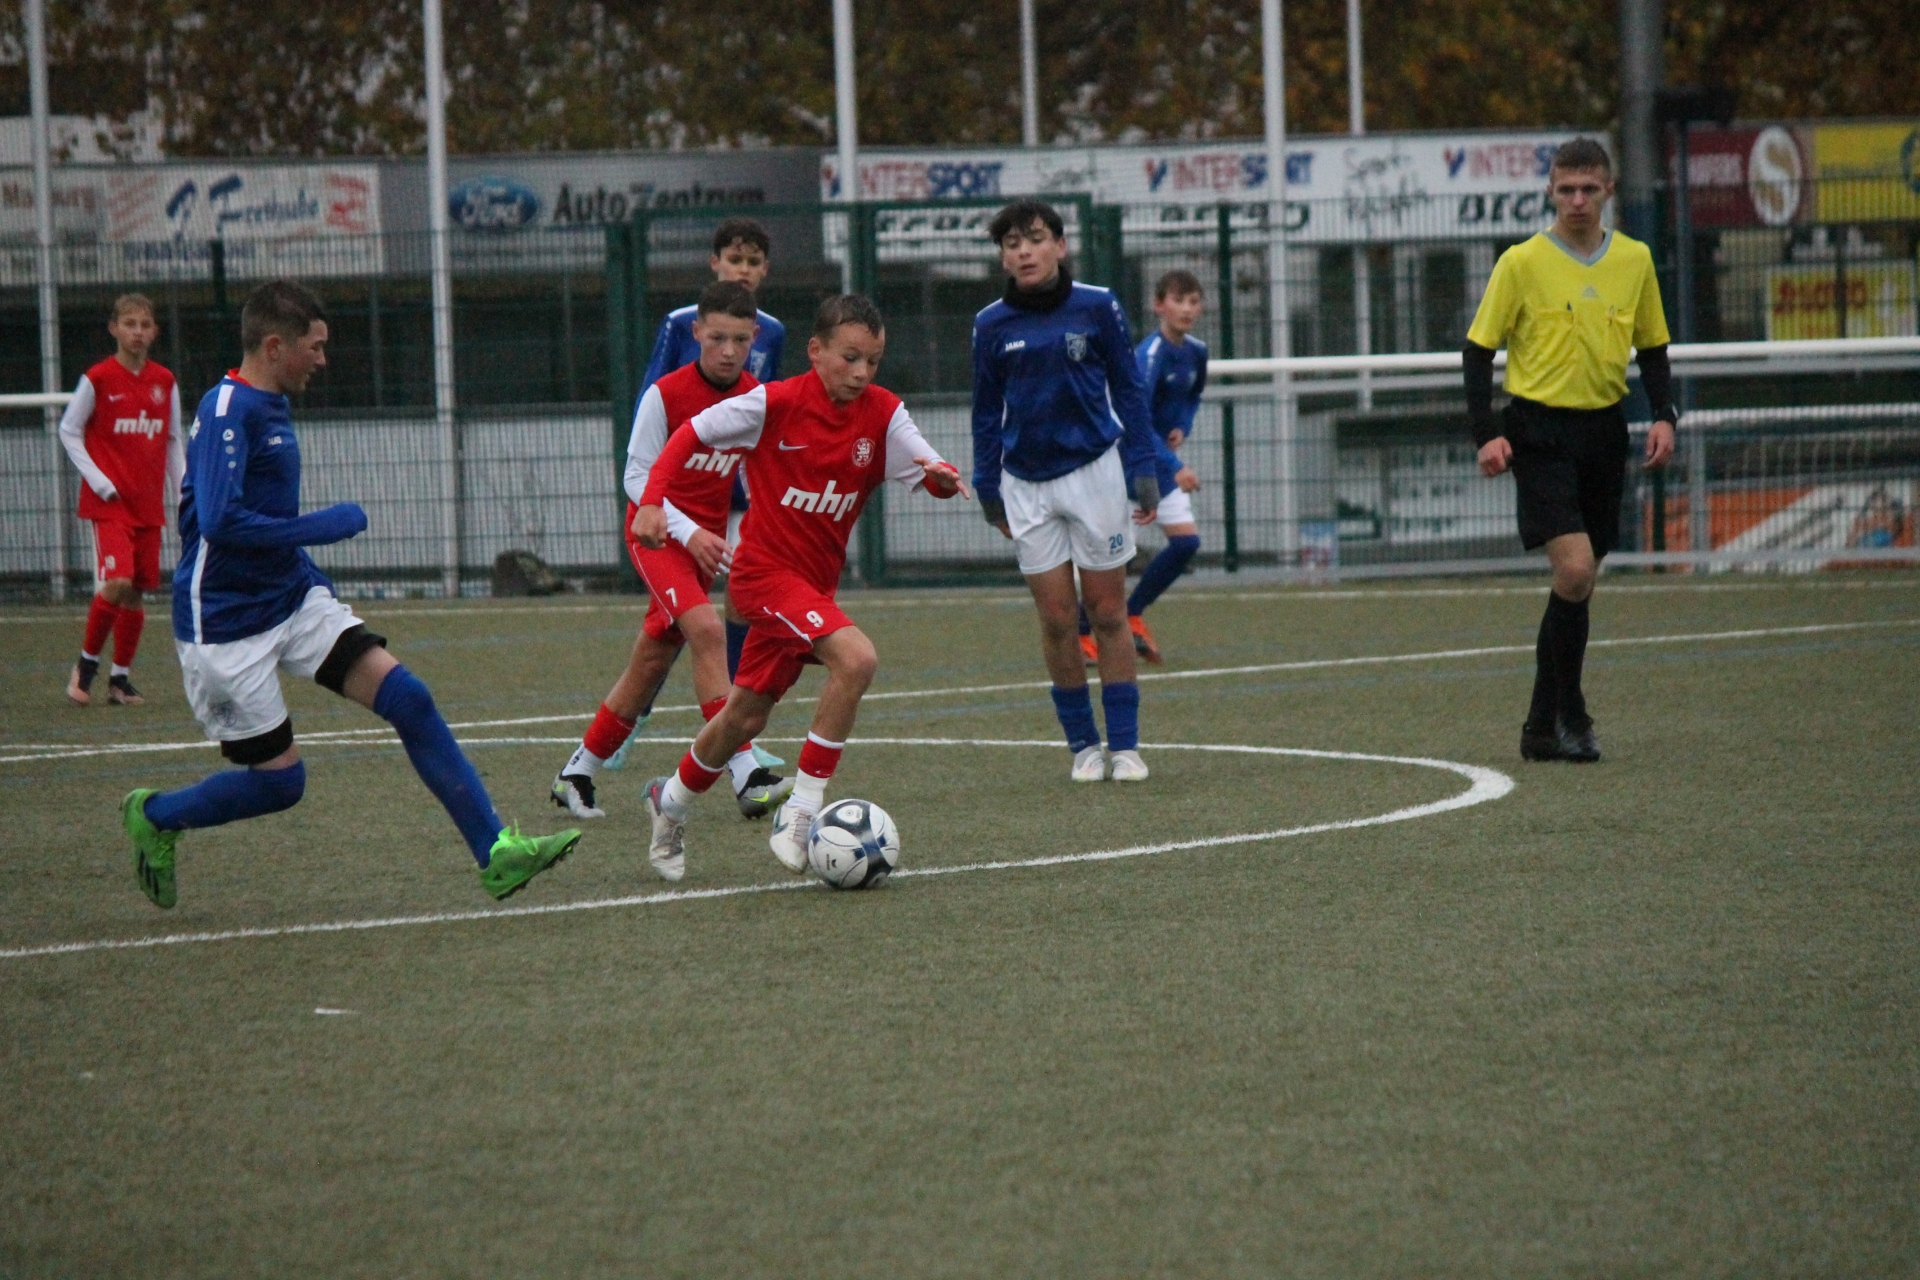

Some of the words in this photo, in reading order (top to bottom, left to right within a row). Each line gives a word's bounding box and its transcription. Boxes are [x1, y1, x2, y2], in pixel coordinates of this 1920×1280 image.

[1005, 340, 1025, 351] JAKO
[113, 409, 164, 440] mhp
[780, 479, 859, 522] mhp
[1108, 533, 1124, 549] 20
[665, 587, 678, 608] 7
[806, 610, 824, 628] 9
